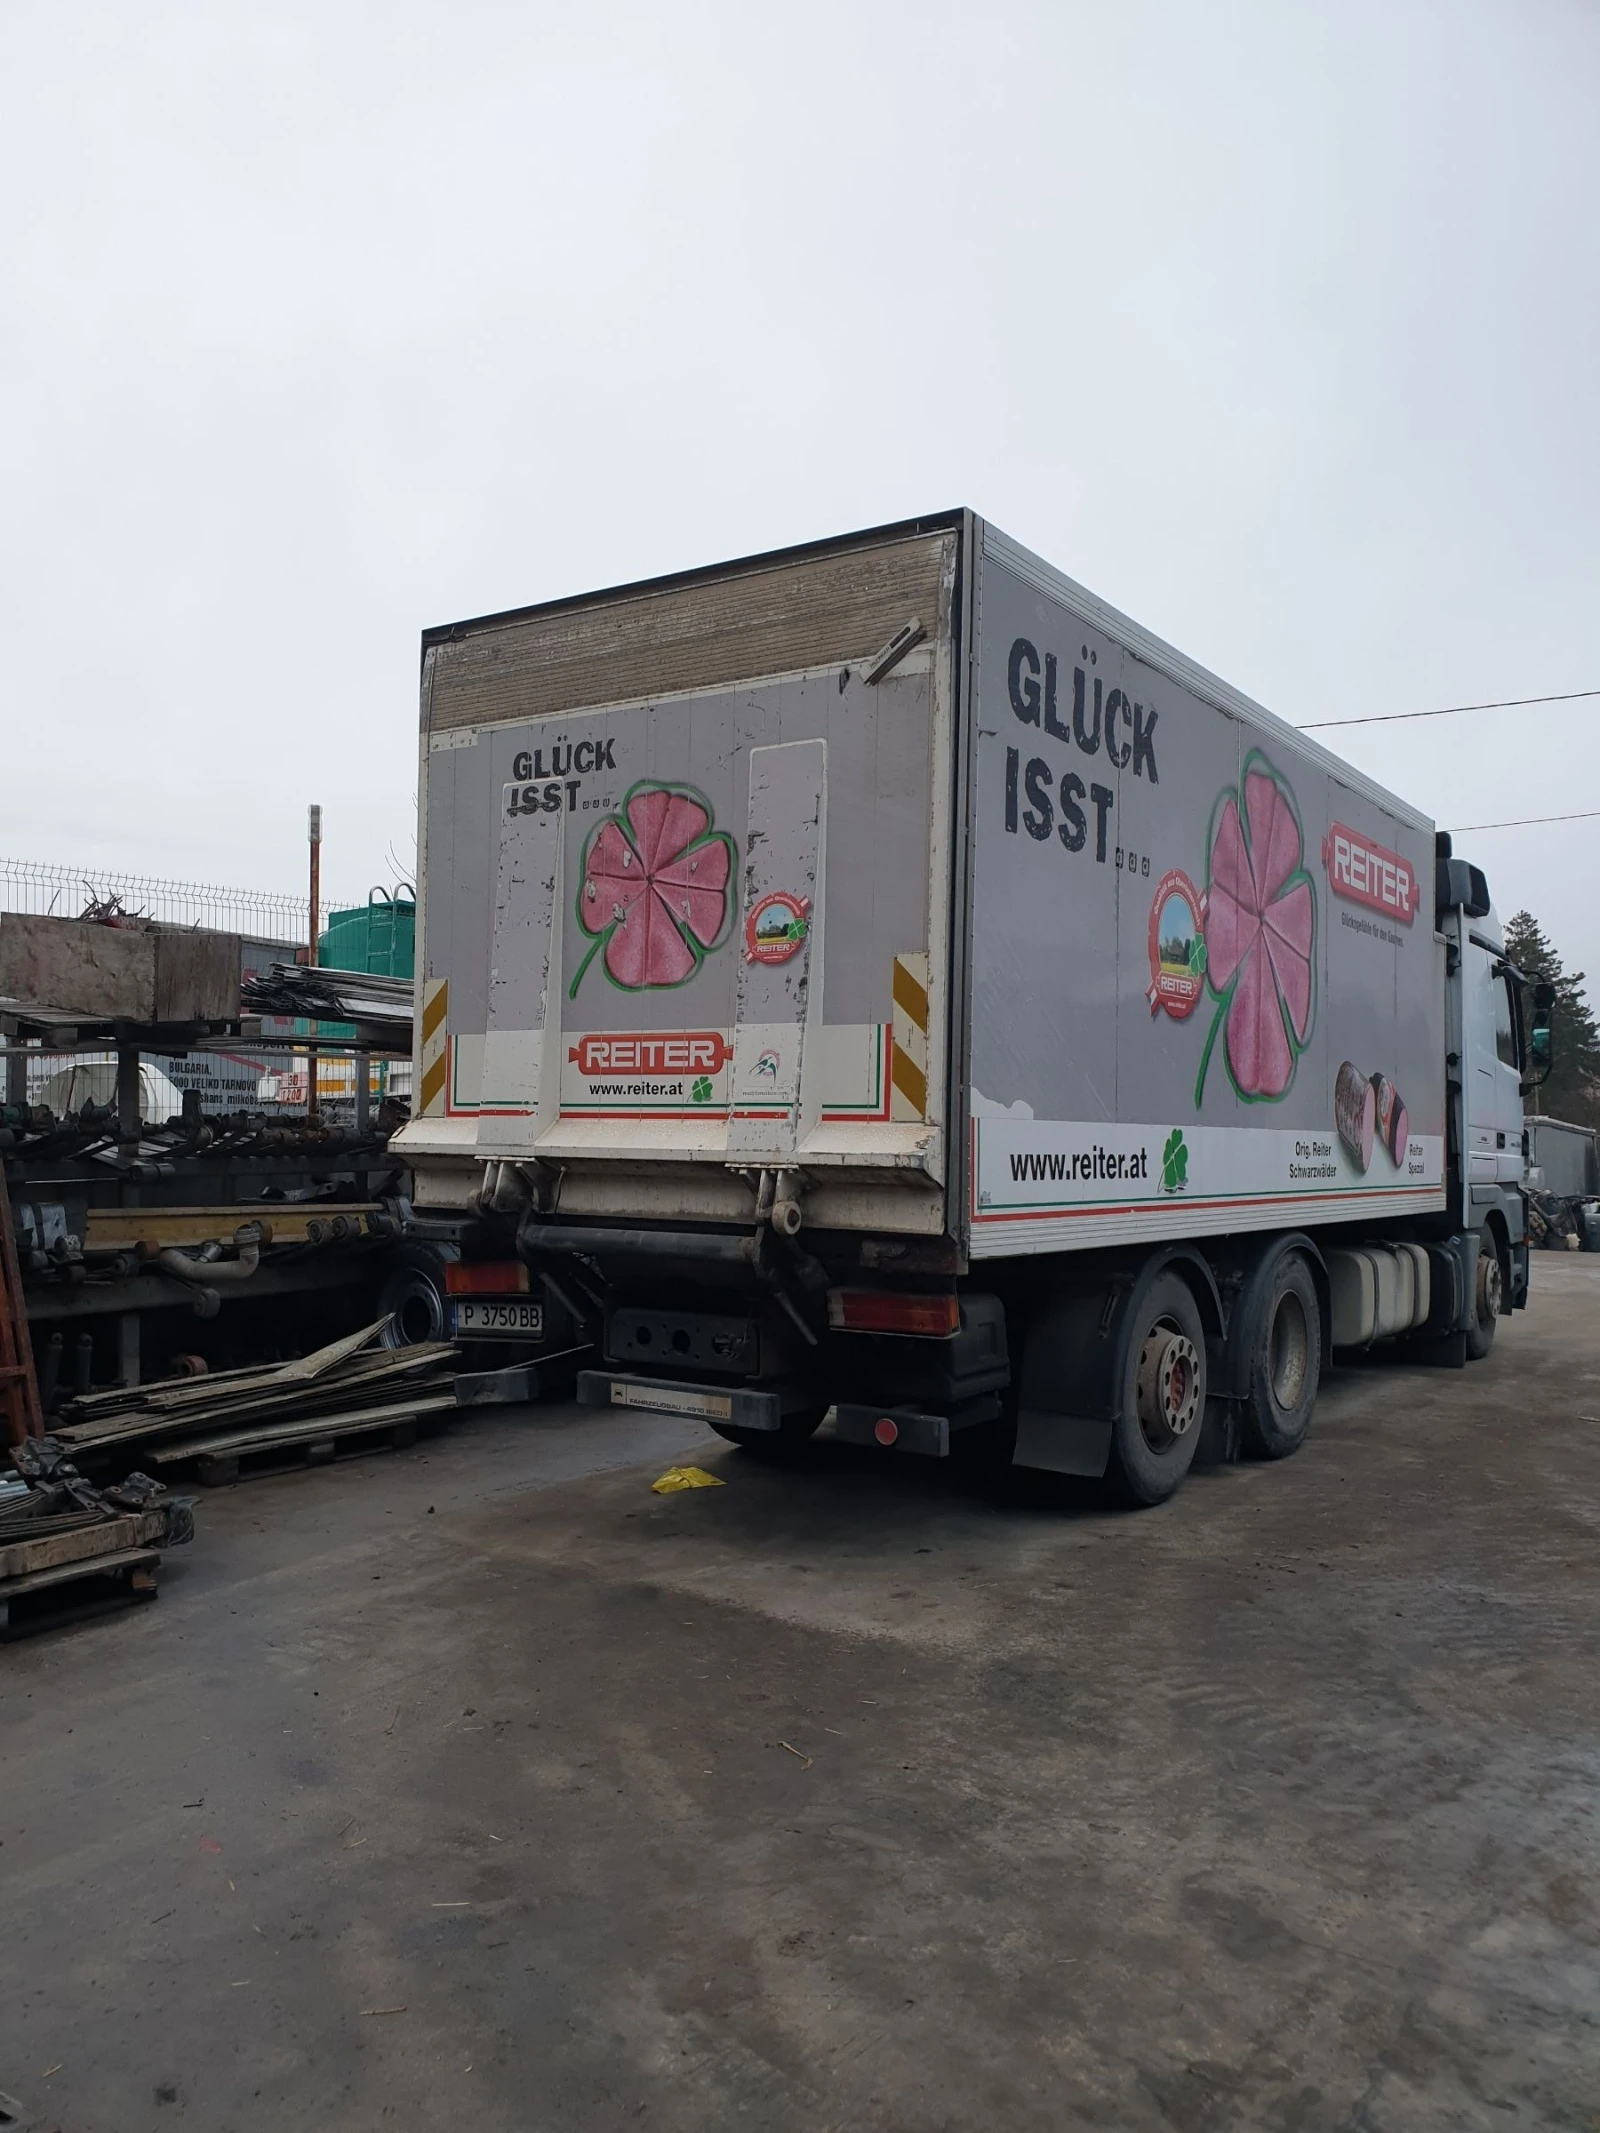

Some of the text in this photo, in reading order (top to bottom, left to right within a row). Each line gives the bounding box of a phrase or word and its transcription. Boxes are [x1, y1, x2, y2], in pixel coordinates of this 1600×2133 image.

[1007, 637, 1159, 784] GLÜCK
[513, 735, 616, 782] GLÜCK
[1334, 834, 1410, 912] REITER
[756, 944, 790, 952] REITER
[1160, 976, 1193, 995] REITER
[586, 1040, 715, 1068] REITER
[191, 1078, 219, 1090] VELIKO
[221, 1079, 257, 1092] TARNOVO
[288, 1075, 298, 1086] 30
[589, 1082, 683, 1096] www.reiter.at
[1295, 1141, 1332, 1159] Orig. Reiter
[1409, 1143, 1423, 1156] Reiter
[1010, 1145, 1148, 1182] www.reiter.at
[1289, 1163, 1337, 1178] Schwarzwälder
[1408, 1162, 1425, 1176] Spezial
[464, 1305, 540, 1328] P 3750 BB
[629, 1398, 681, 1411] FAHRZEUGBAU
